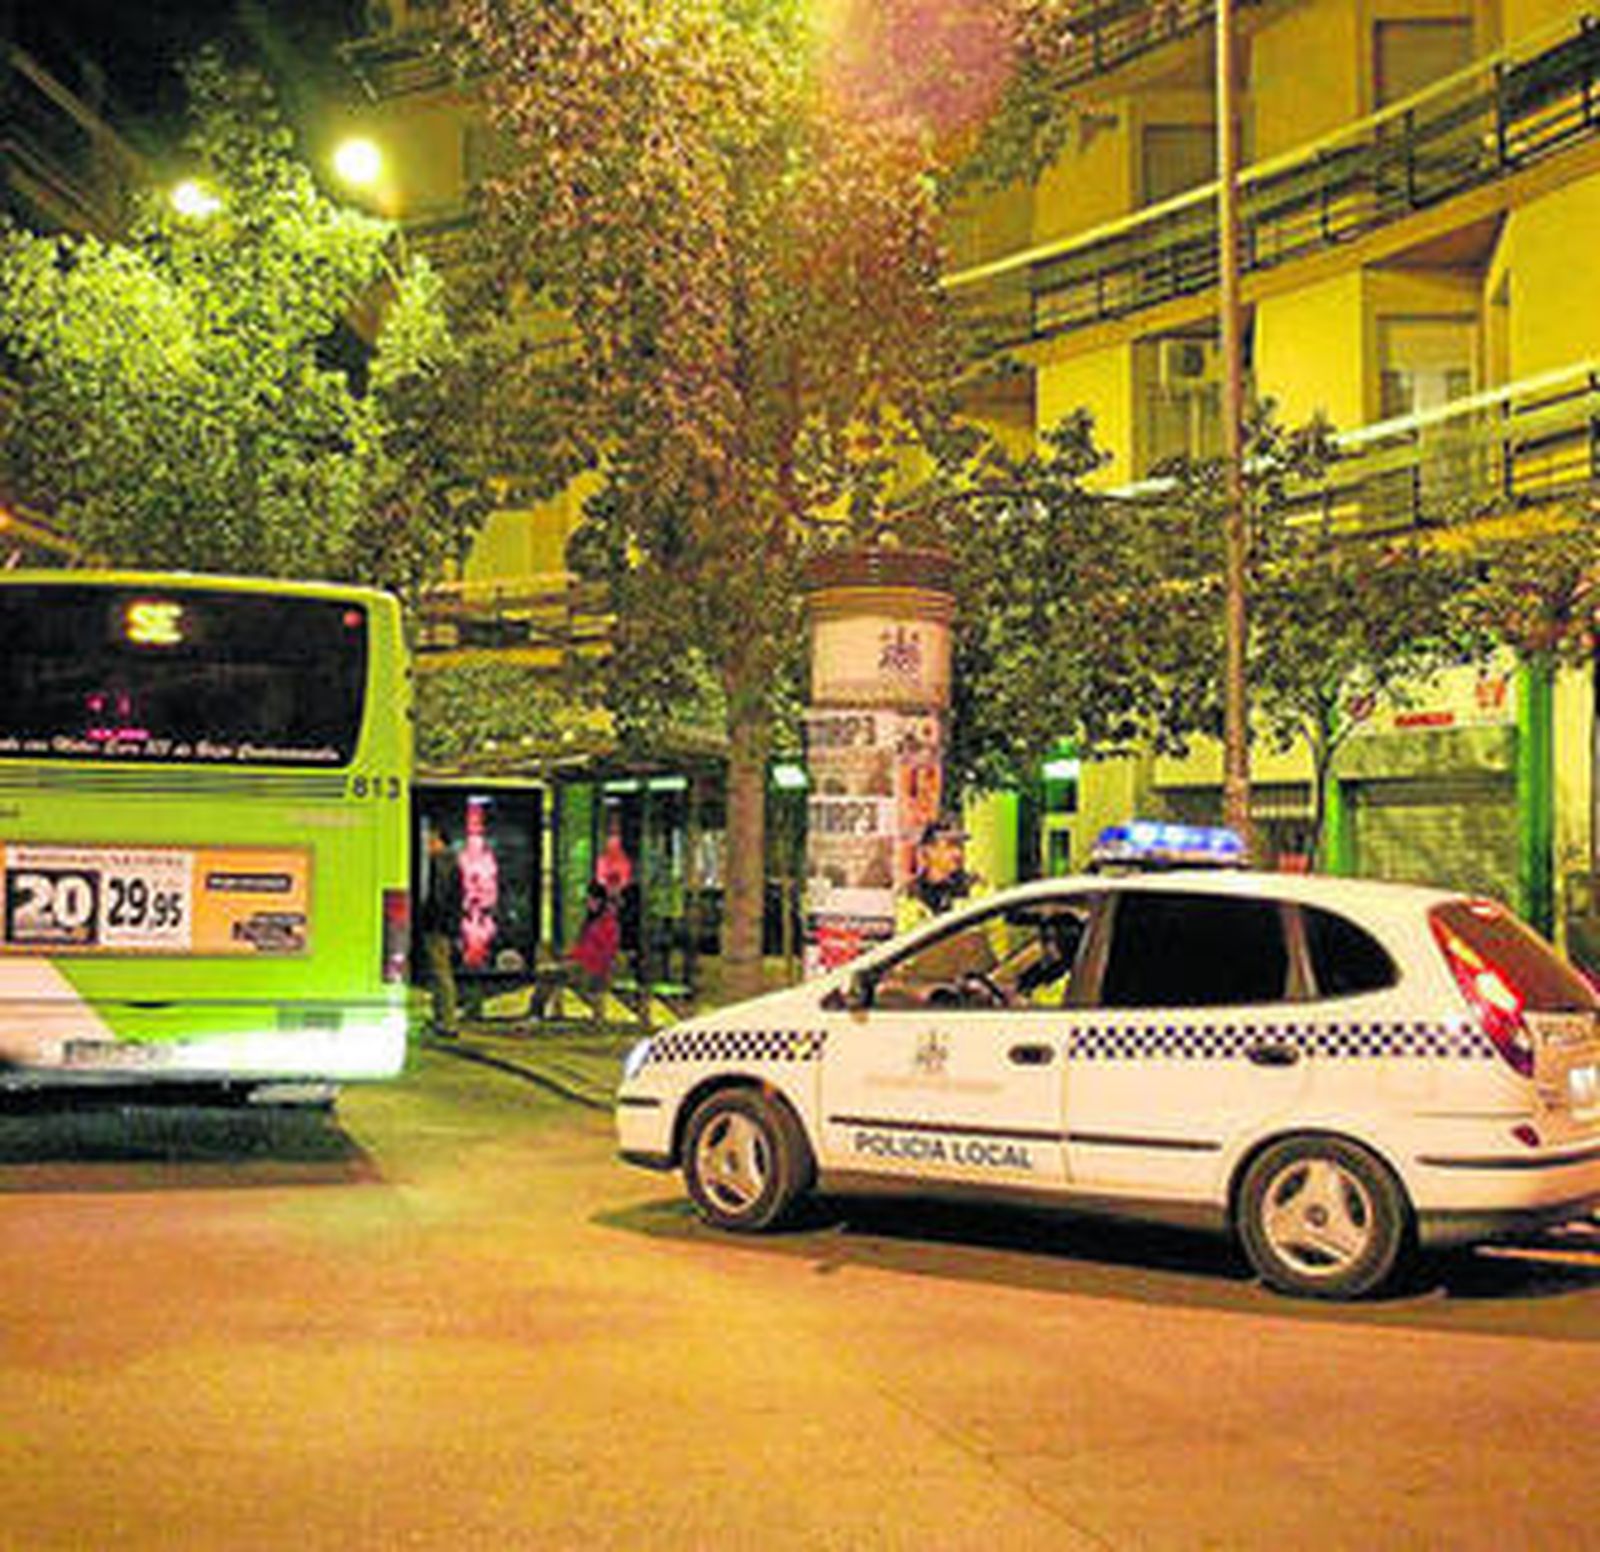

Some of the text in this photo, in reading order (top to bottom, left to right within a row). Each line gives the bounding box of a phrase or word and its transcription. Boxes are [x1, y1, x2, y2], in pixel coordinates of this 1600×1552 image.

[353, 776, 400, 801] 813
[13, 873, 93, 929] 20
[854, 1131, 1034, 1169] POLICIA LOCAL
